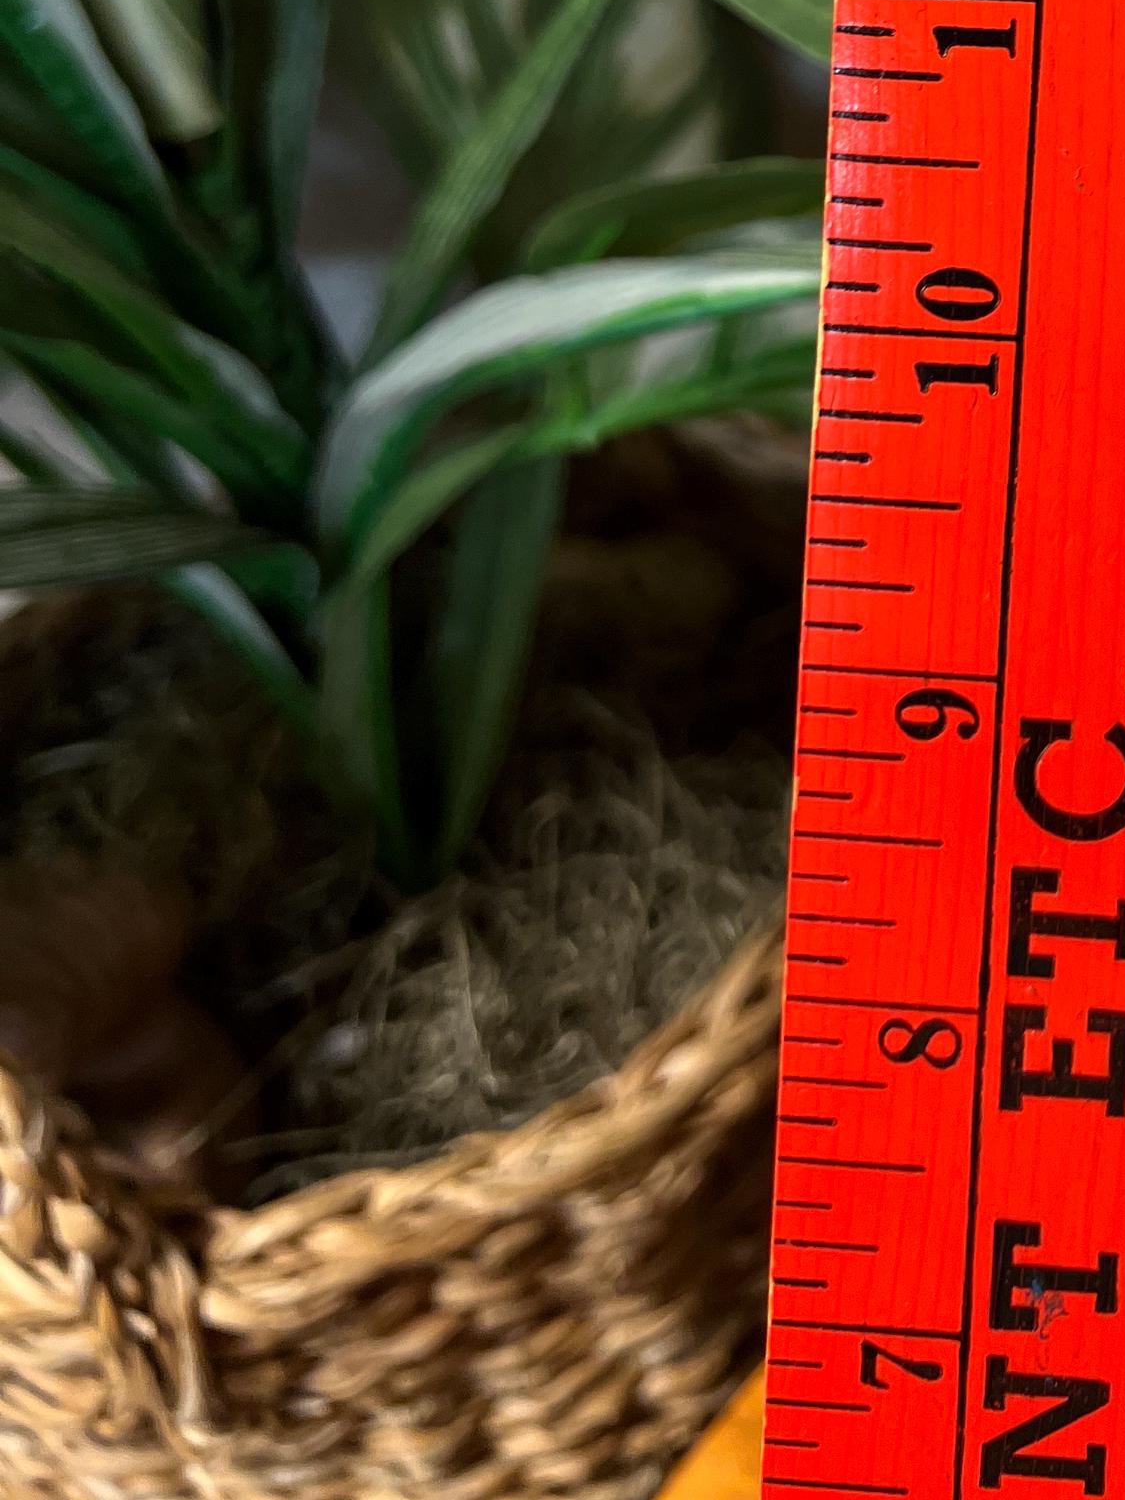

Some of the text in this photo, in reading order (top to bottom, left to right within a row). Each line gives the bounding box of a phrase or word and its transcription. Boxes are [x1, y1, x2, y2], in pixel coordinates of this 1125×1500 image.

[914, 266, 1001, 396] 10
[894, 686, 982, 742] 9
[877, 1017, 962, 1070] 8
[859, 1339, 944, 1391] 7
